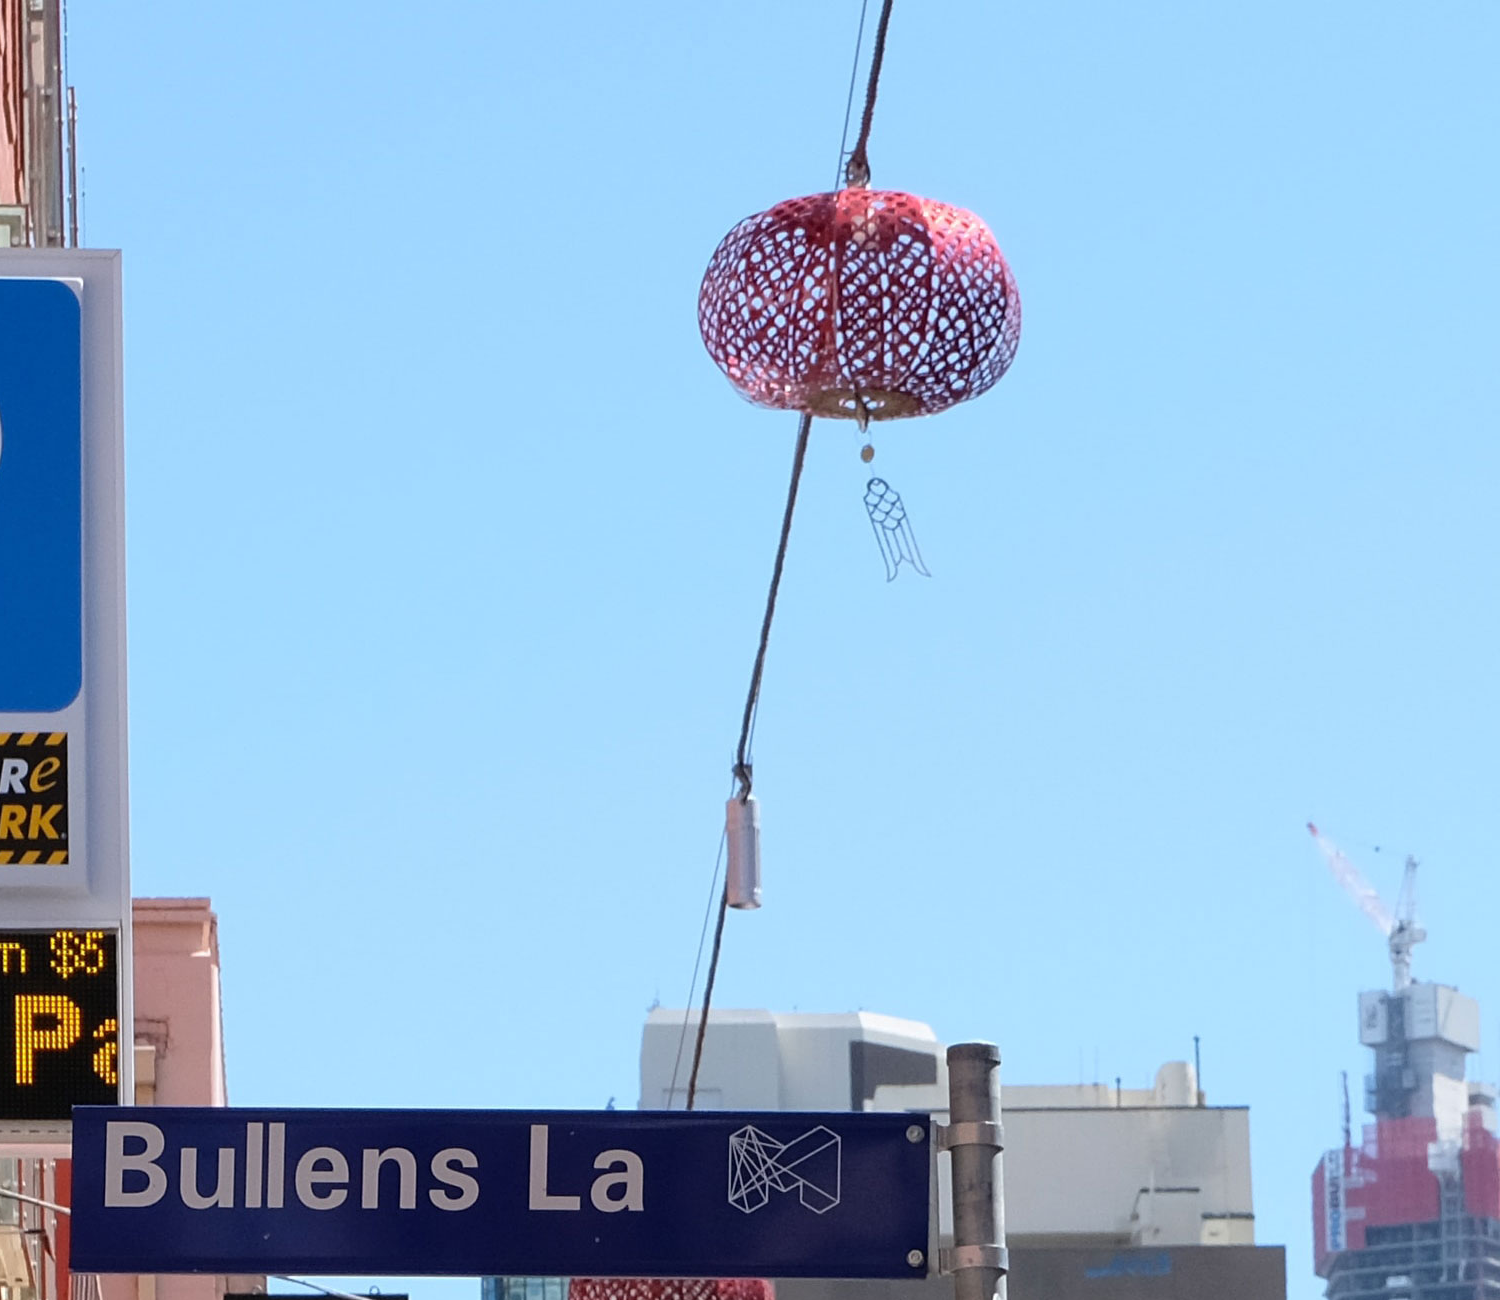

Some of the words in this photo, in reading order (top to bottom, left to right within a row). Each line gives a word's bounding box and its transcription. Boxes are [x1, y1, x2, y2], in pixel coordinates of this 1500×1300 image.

[50, 932, 106, 980] $5
[104, 1121, 481, 1211] Bullens
[528, 1124, 646, 1212] La
